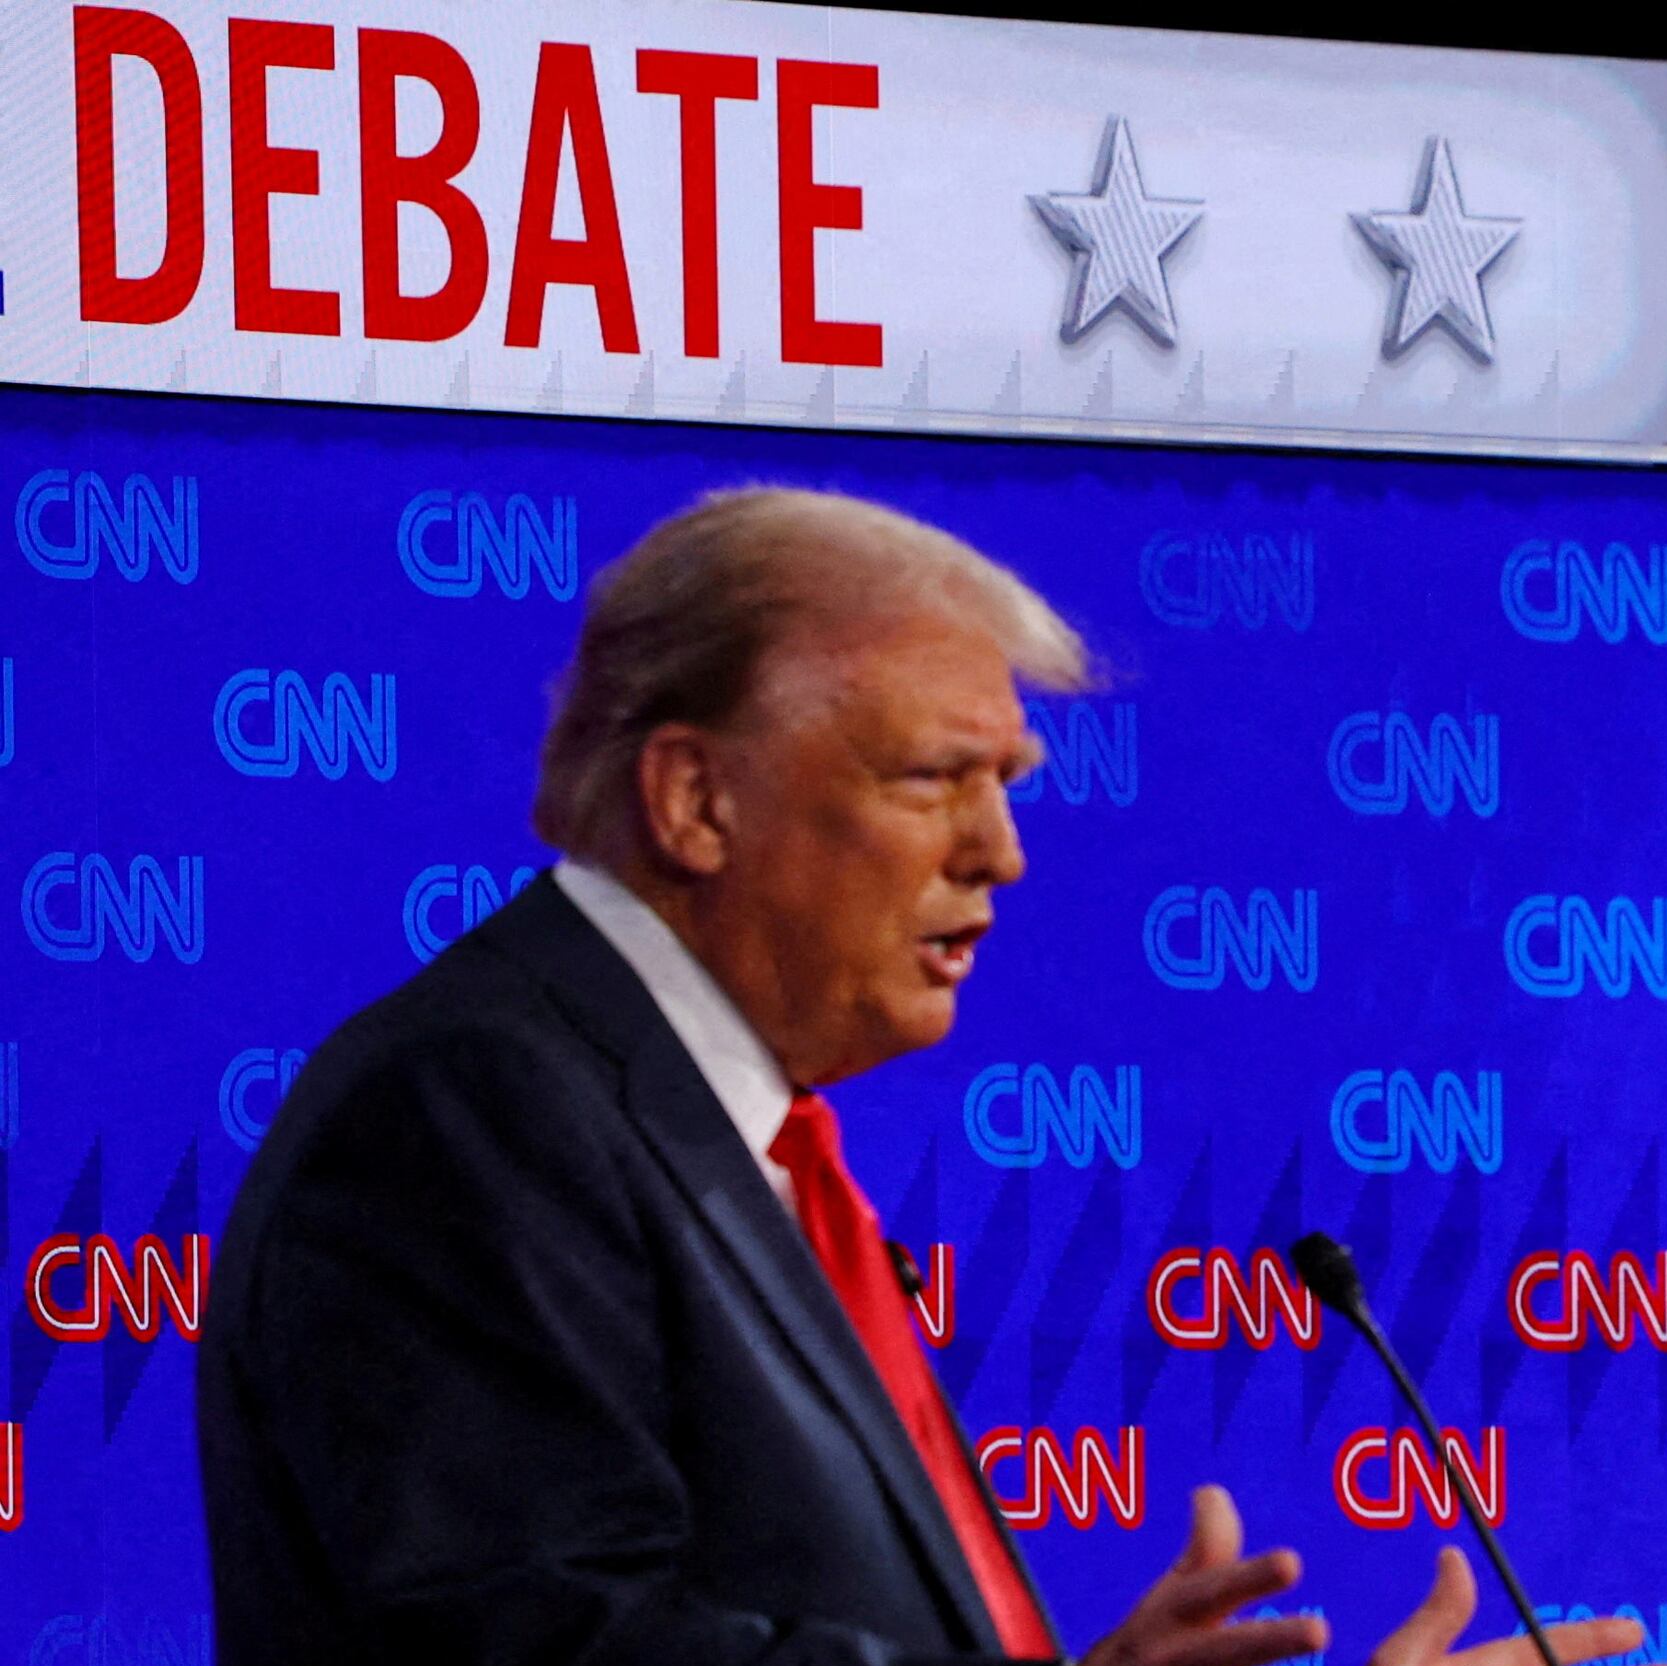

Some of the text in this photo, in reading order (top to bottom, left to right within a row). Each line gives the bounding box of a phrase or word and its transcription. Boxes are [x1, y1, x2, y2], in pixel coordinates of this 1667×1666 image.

[73, 4, 884, 368] DEBATE
[15, 467, 199, 584] CNN
[399, 490, 579, 601] CNN
[1139, 529, 1317, 632] CNN
[214, 668, 397, 783] CNN
[1006, 702, 1139, 806] NN
[1327, 710, 1503, 819] CNN
[22, 850, 205, 965] CNN
[404, 863, 540, 966] CN
[1143, 885, 1320, 993] CNN
[963, 1061, 1143, 1171] CNN
[1330, 1067, 1505, 1176] CNN
[26, 1233, 209, 1342] CNN
[1147, 1246, 1320, 1349] CNN
[976, 1424, 1145, 1529] CNN
[1333, 1425, 1506, 1529] CNN
